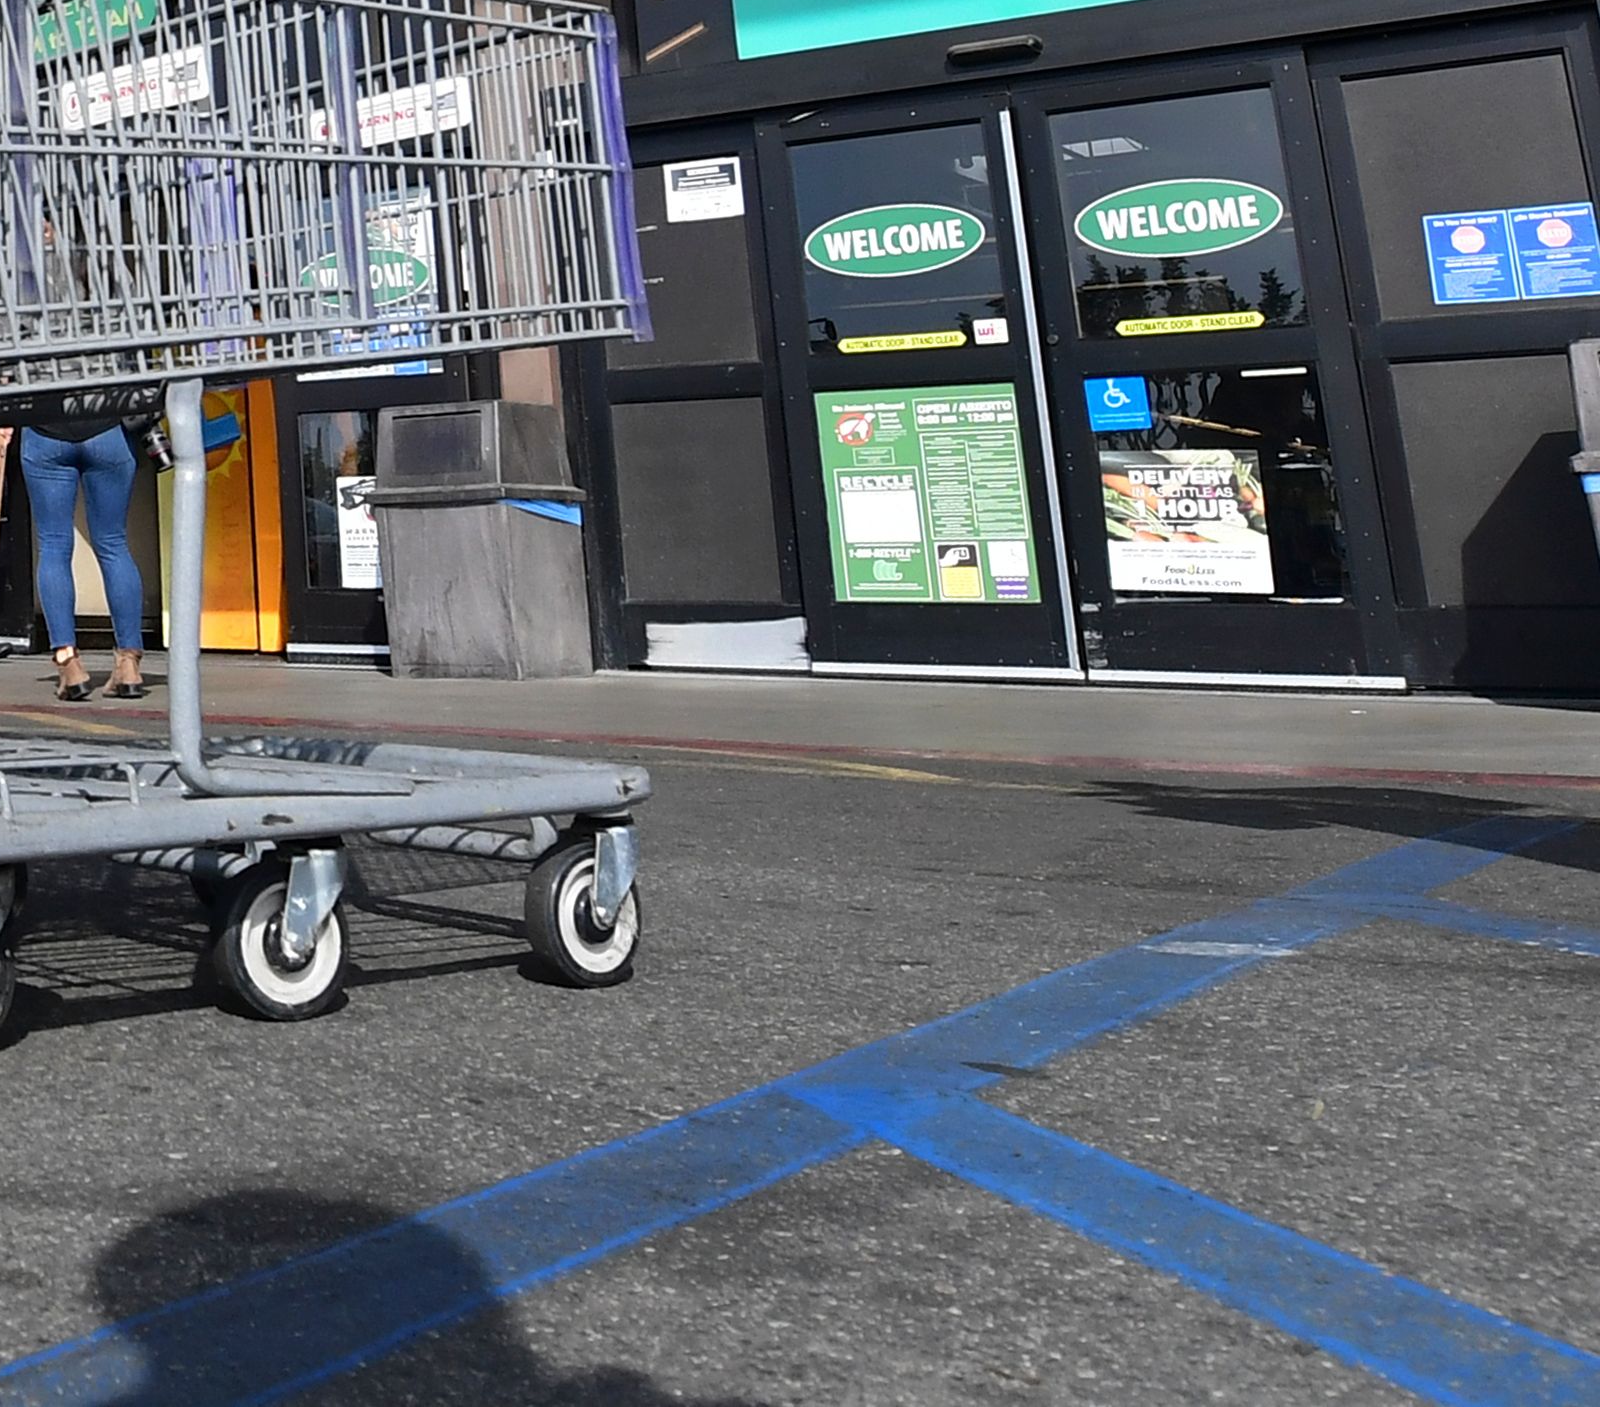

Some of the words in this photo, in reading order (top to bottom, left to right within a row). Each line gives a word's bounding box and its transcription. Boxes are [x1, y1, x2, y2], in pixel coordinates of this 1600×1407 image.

[99, 78, 157, 103] WRNNG
[358, 107, 416, 130] ARNNG
[1095, 194, 1260, 241] WELCOME
[822, 218, 966, 262] WELCOME
[311, 261, 415, 290] WOME
[1124, 319, 1168, 333] AUTOMATIC
[1170, 318, 1193, 330] DOOR
[1200, 317, 1226, 328] STAND
[1228, 314, 1256, 327] CLEAR
[846, 339, 883, 350] AUTOMATIC
[885, 338, 905, 349] DOOR
[911, 336, 934, 347] STAND
[936, 334, 960, 345] CLEAR
[916, 403, 951, 415] OPEN
[959, 400, 1012, 413] ABIERTO
[840, 474, 914, 490] RECYCLE
[1128, 469, 1233, 486] DELIVERY
[1150, 487, 1163, 498] AS
[1214, 487, 1233, 498] AS
[1157, 499, 1238, 518] HOUR
[1142, 576, 1242, 587] Food4Less.com
